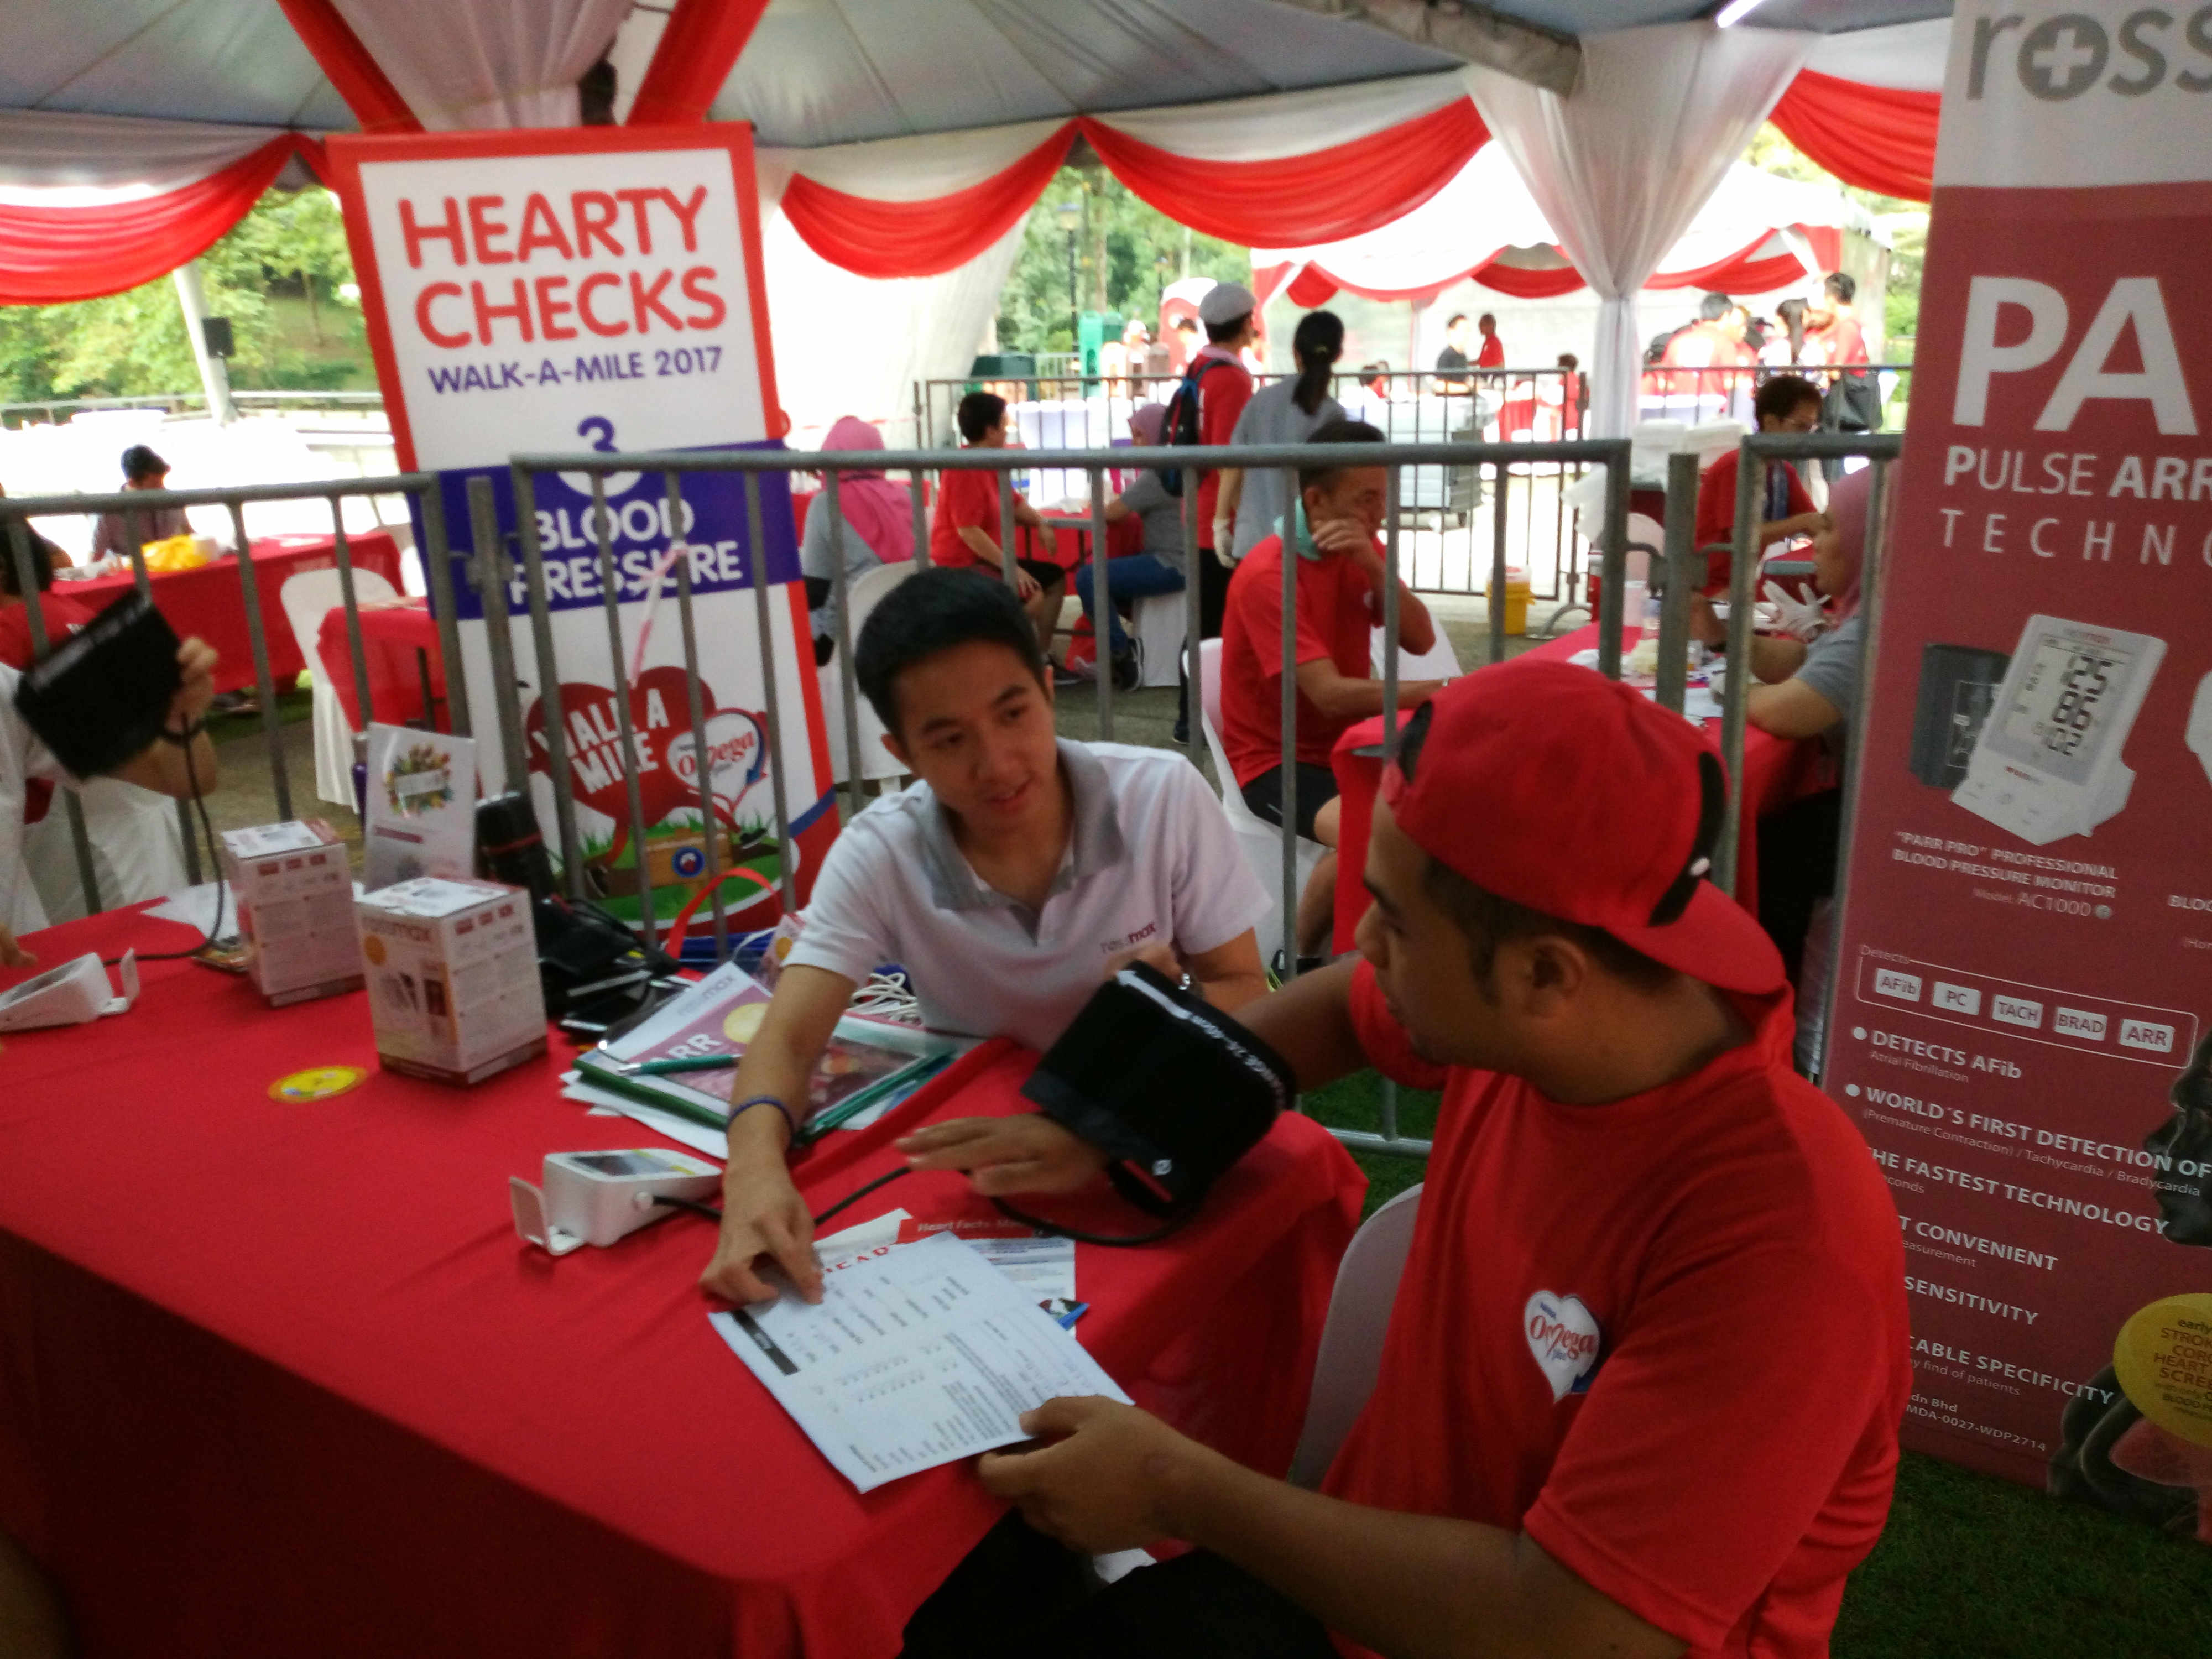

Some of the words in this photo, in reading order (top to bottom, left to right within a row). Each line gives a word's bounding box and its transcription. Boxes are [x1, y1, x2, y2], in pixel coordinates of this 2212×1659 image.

[398, 185, 708, 269] HEARTY
[414, 266, 727, 349] CHECKS
[428, 351, 646, 394] WALK-A-MILE
[655, 345, 723, 377] 2017
[1957, 275, 2199, 436] PA
[1944, 444, 2098, 497] PULSE
[1940, 508, 2212, 567] TECHN
[646, 688, 669, 729] A
[1892, 848, 1948, 870] BLOOD
[1949, 858, 2031, 885] PRESSURE
[2034, 874, 2116, 899] MONITOR
[1991, 848, 2119, 880] PROFESSIONAL
[1880, 975, 1916, 995] AFib
[1946, 989, 1968, 1006] PC
[1997, 1001, 2039, 1022] TACH
[2058, 1013, 2104, 1034] BRAD
[2125, 1026, 2168, 1046] ARR
[650, 1033, 723, 1062] RR
[1870, 1050, 1901, 1066] Atrial
[1905, 1058, 1969, 1083] Fibrillation
[1871, 1030, 1967, 1067] DETECTS
[1970, 1054, 2022, 1079] AFib
[1969, 1113, 2032, 1141] FIRST
[2037, 1129, 2172, 1172] DETECTION
[2178, 1159, 2212, 1179] OF
[1867, 1146, 1900, 1168] HE
[1905, 1157, 2000, 1195] FASTEST
[2003, 1183, 2170, 1235] TECHNOLOGY
[2024, 1149, 2104, 1177] Tachycardia
[2116, 1170, 2200, 1197] Bradycardia
[1916, 1221, 2059, 1271] CONVENIENT
[1903, 1275, 2039, 1326] SENSITIVITY
[1530, 1315, 1596, 1360] Omega
[1931, 1397, 1958, 1413] Bhd
[1966, 1373, 2022, 1397] patients
[1975, 1355, 2115, 1406] SPECIFICITY
